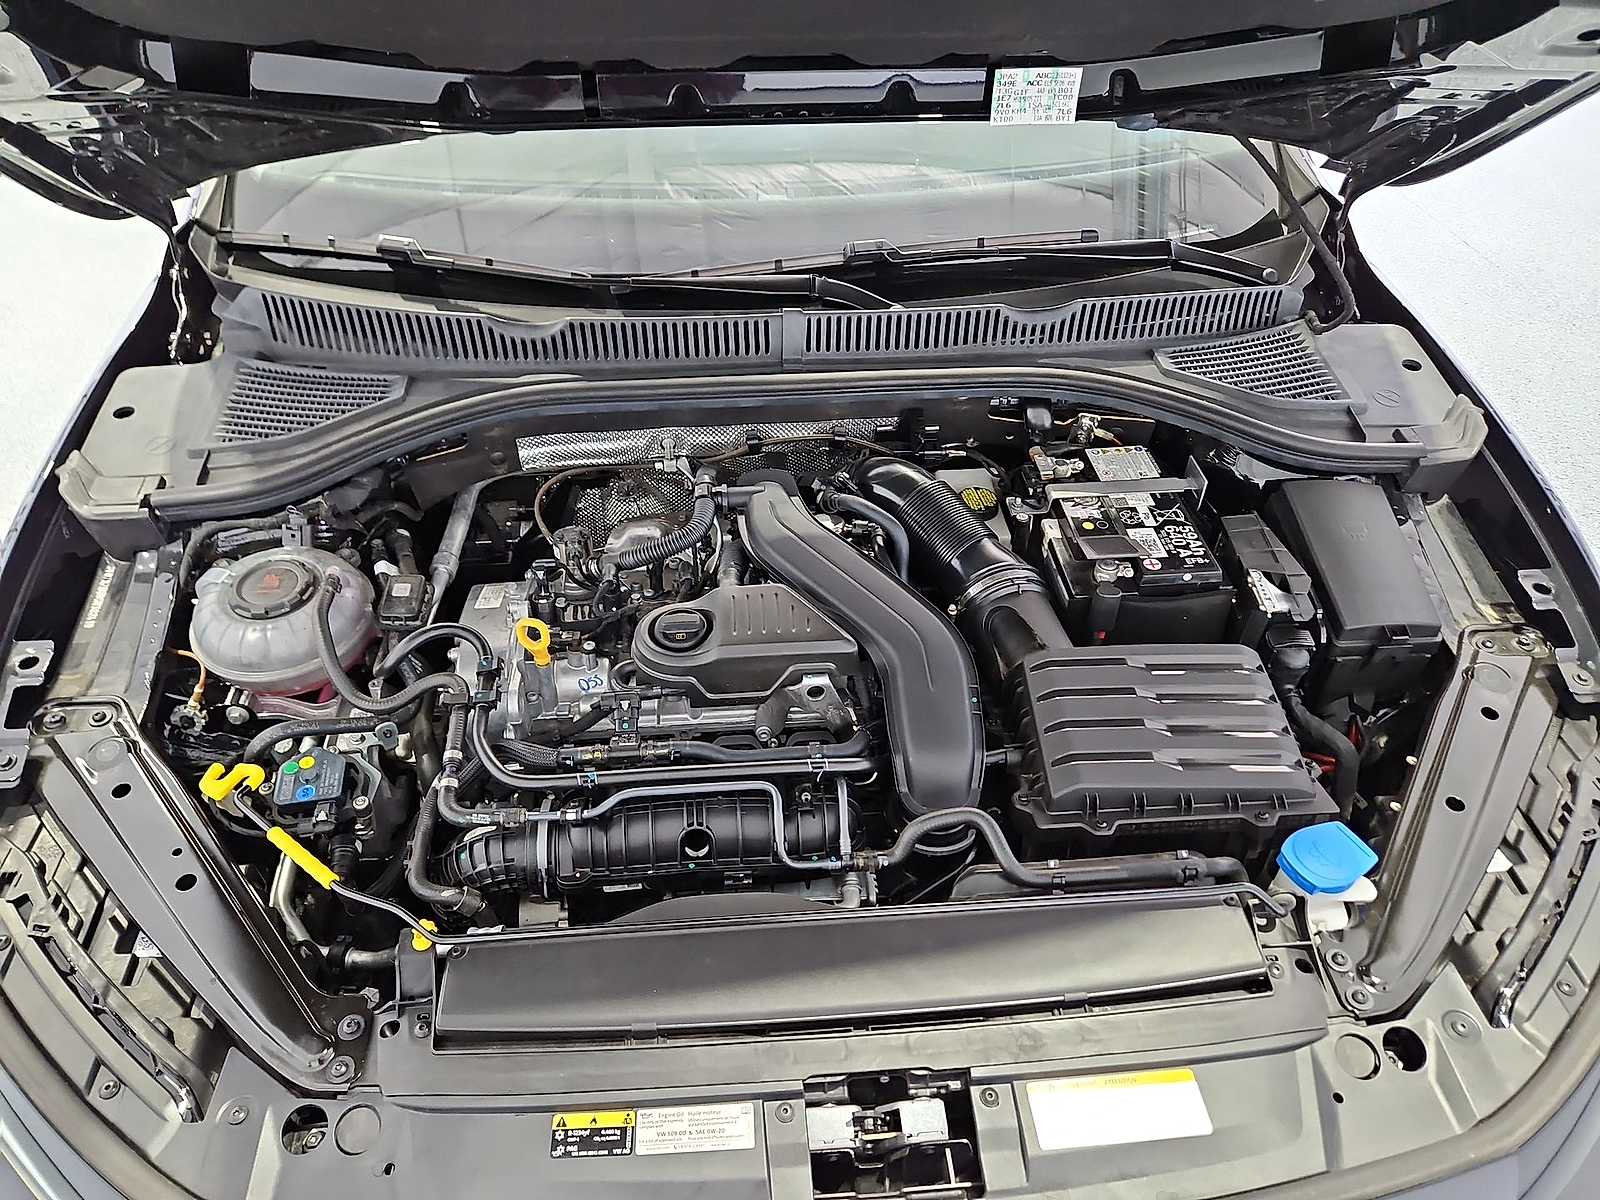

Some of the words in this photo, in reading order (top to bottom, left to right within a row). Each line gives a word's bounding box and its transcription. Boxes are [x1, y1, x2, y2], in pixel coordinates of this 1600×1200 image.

[1164, 526, 1187, 546] 640
[1176, 548, 1193, 558] A
[1180, 526, 1206, 556] 59Ah
